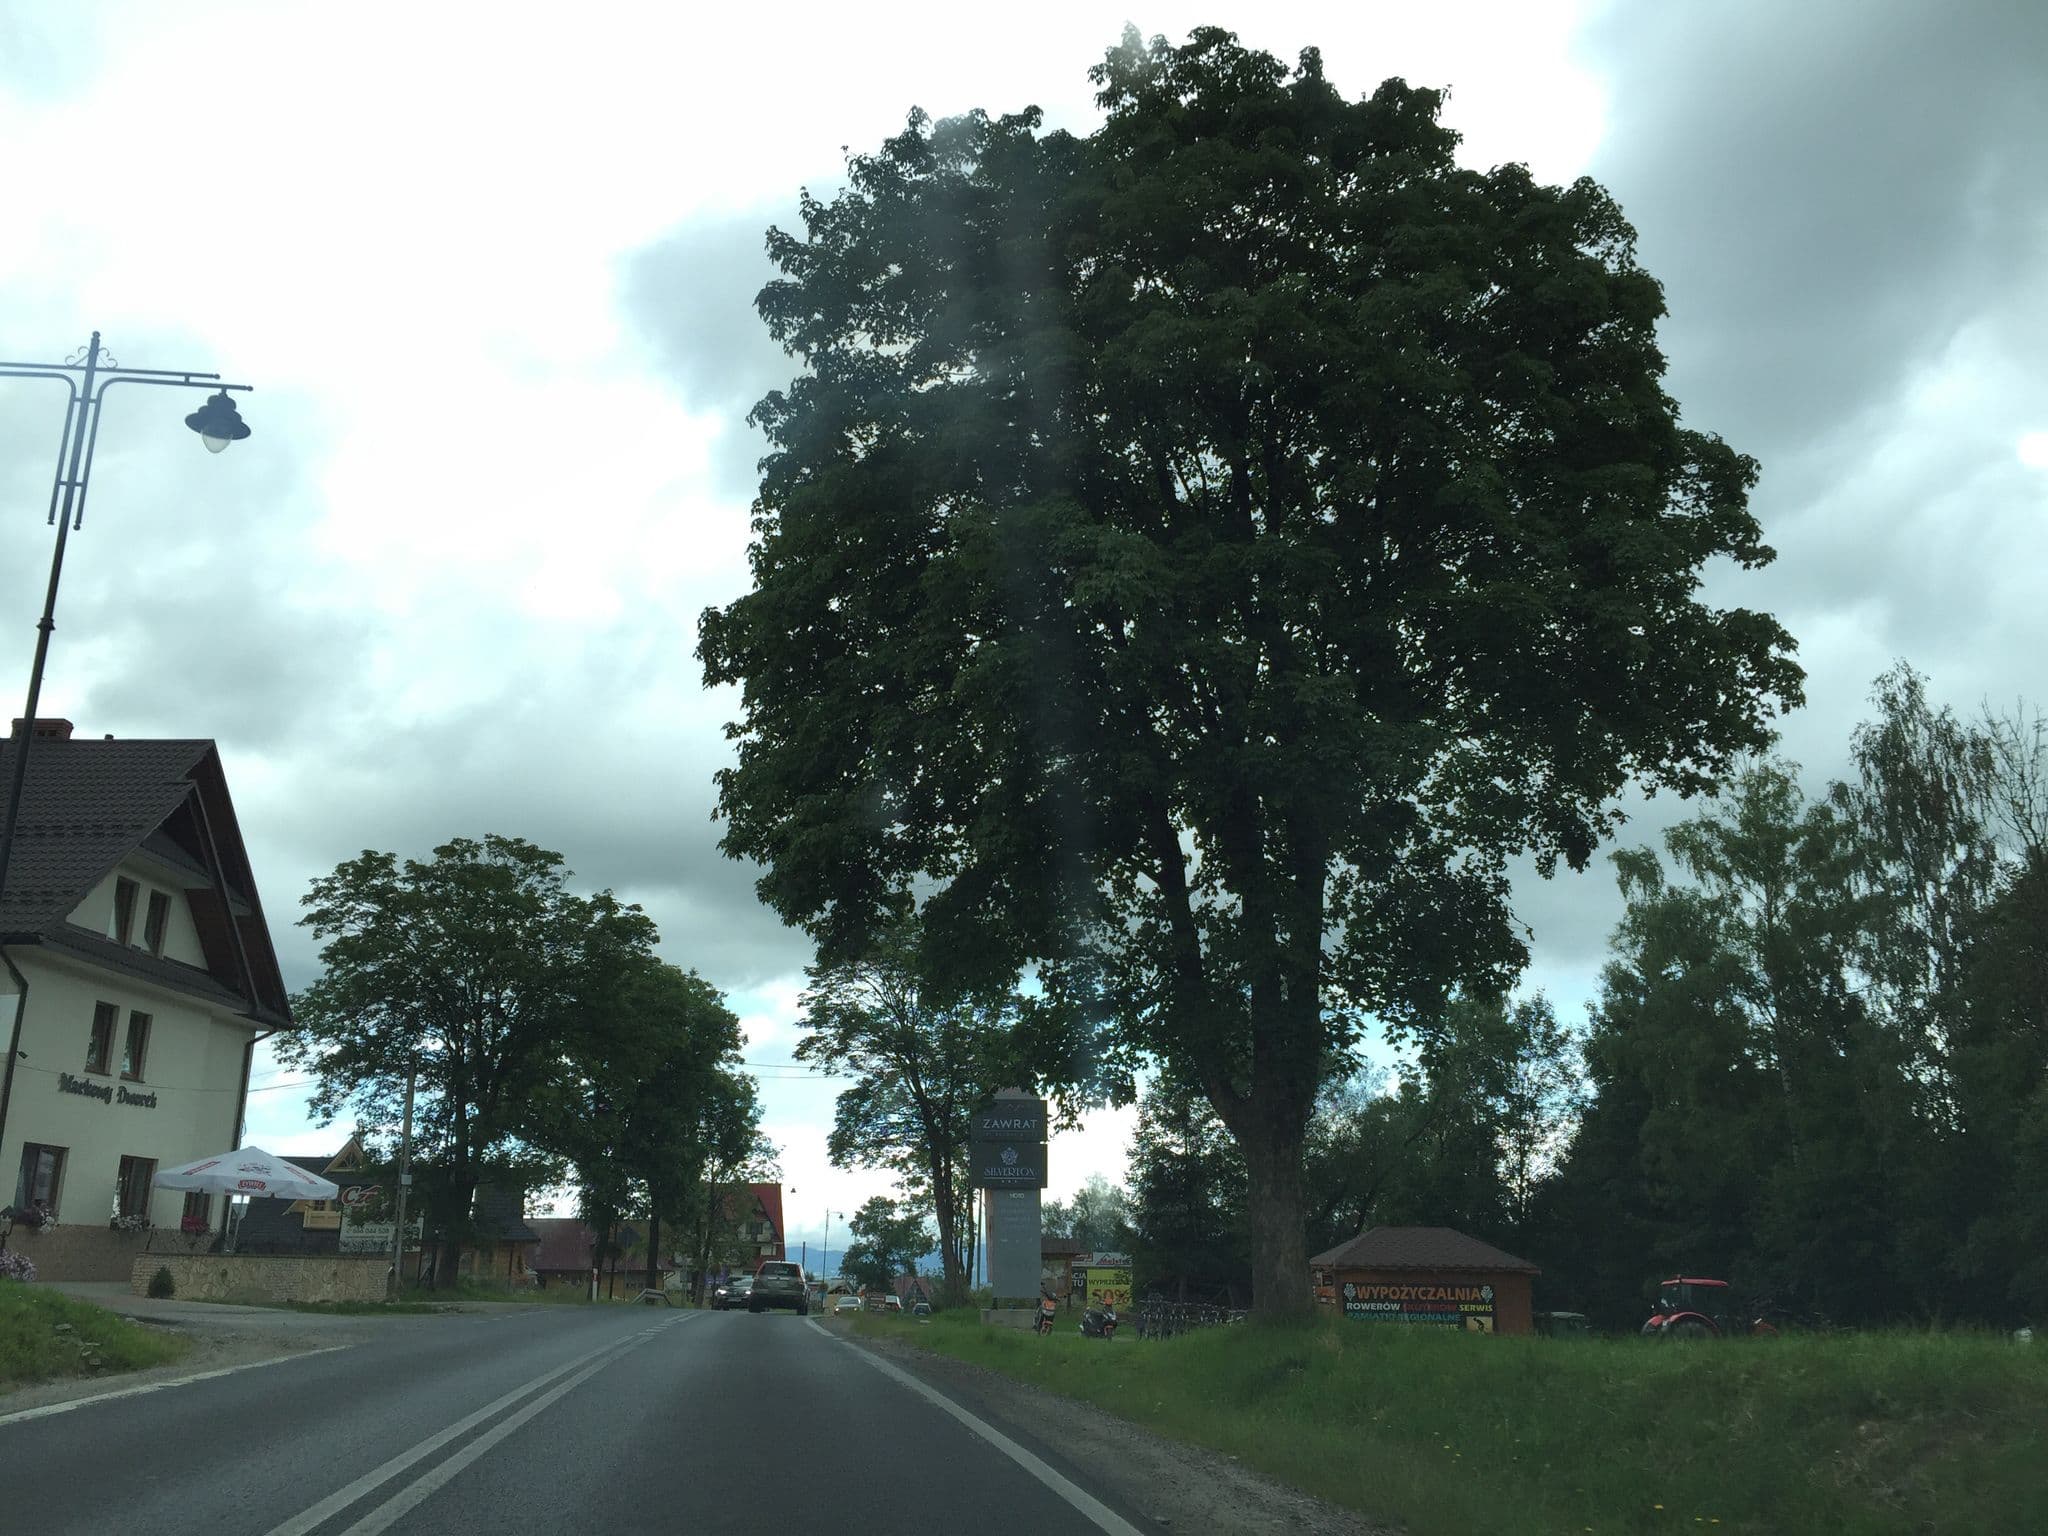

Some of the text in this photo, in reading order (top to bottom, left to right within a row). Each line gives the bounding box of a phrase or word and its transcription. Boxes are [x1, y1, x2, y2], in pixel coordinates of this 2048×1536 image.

[982, 1118, 1038, 1129] ZAWRAT
[1356, 1285, 1482, 1300] WYPOŻYCZALNIA
[1346, 1301, 1400, 1311] ROWERÓW
[1458, 1304, 1493, 1312] SERWIS
